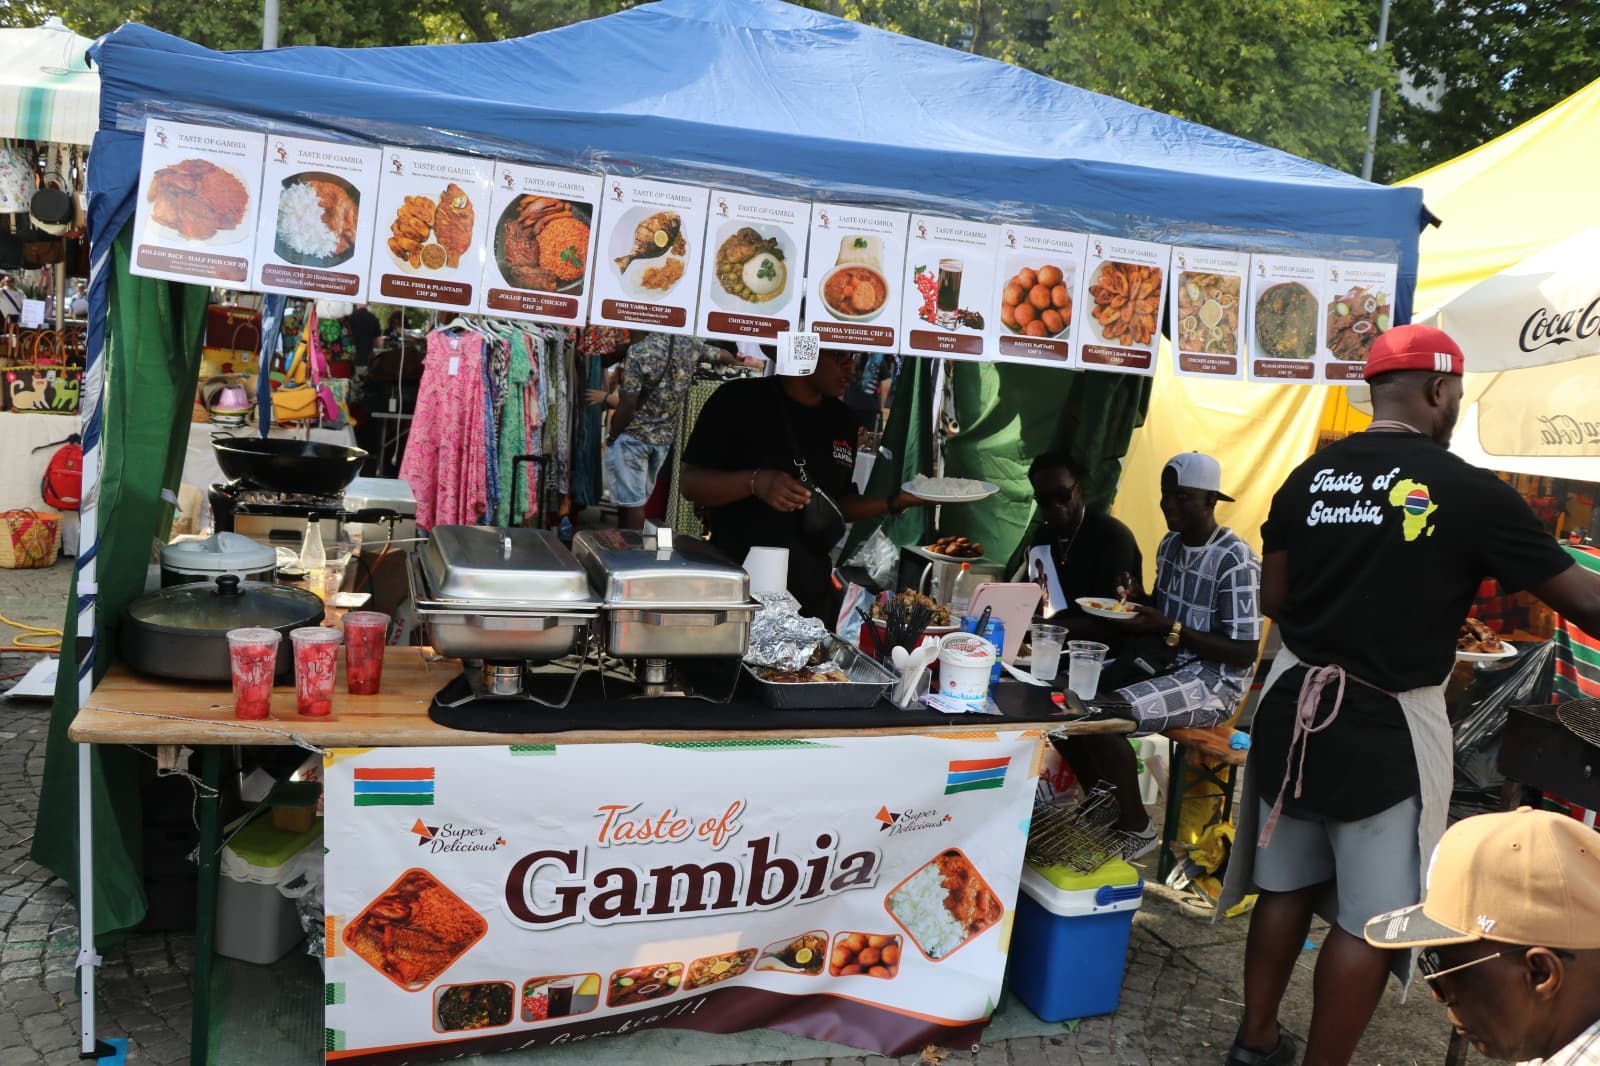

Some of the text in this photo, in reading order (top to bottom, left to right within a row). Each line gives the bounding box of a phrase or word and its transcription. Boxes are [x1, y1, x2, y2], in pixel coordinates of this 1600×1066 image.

[179, 134, 247, 150] TASTE OF GAMBIA
[298, 150, 363, 166] TASTE OF GAMBIA
[414, 161, 436, 171] TASTE
[437, 165, 447, 173] OF
[524, 177, 585, 192] TASTE OF GAMBIA
[633, 189, 654, 198] TASTE
[665, 194, 692, 203] GAMBIA
[738, 205, 758, 213] TASTE
[768, 208, 795, 218] GAMBIA
[839, 216, 858, 224] TASTE
[868, 219, 893, 228] GAMBIA
[936, 227, 954, 235] TASTE
[964, 230, 987, 239] GAMBIA
[168, 252, 184, 260] RICE
[188, 255, 205, 263] HALF
[432, 284, 463, 294] PLANTAIN
[498, 294, 521, 302] JOLLOF
[540, 298, 568, 307] CHICKEN
[1518, 296, 1600, 353] Coca-C
[1309, 467, 1401, 495] Taste of
[1306, 499, 1384, 527] Gambia
[900, 808, 937, 822] Super
[440, 823, 486, 840] Super
[595, 799, 743, 849] Taste of
[889, 820, 942, 837] Delicious
[430, 838, 497, 855] Delicious
[504, 832, 877, 925] Gambia
